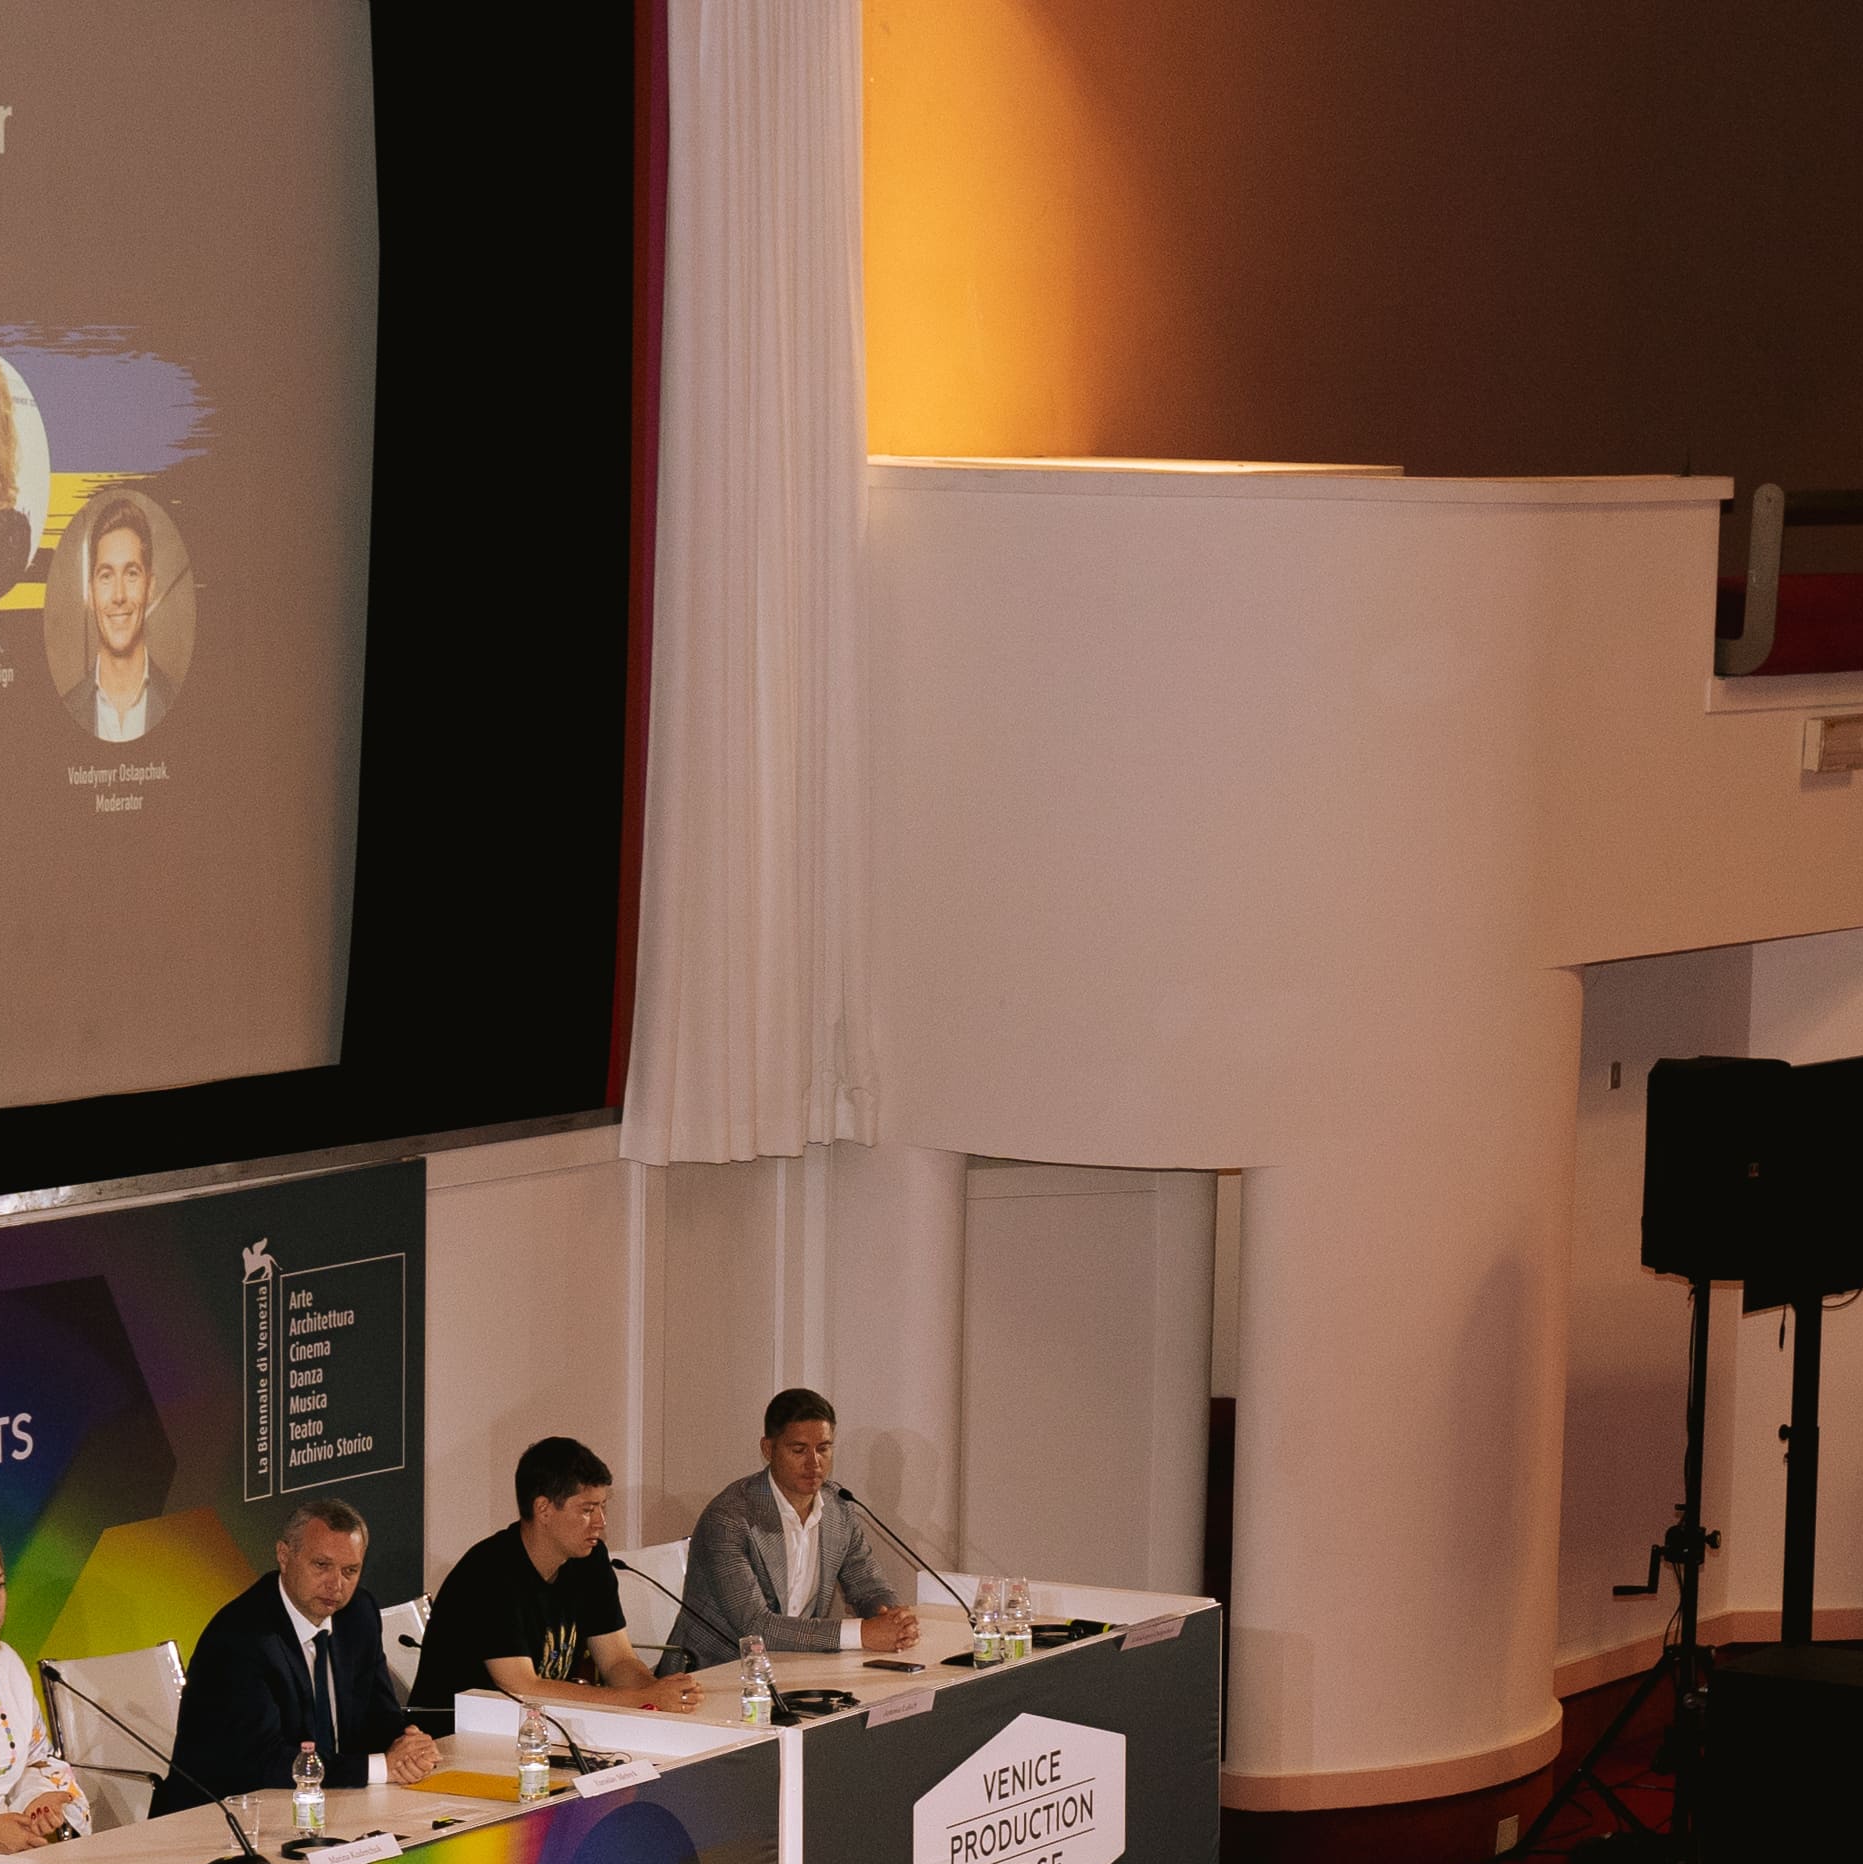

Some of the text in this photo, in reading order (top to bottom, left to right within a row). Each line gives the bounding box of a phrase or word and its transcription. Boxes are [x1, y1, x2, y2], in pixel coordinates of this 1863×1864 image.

[67, 765, 117, 789] Volodymyr
[96, 793, 144, 813] Moderator
[289, 1289, 313, 1311] Arte
[289, 1309, 355, 1337] Architettura
[289, 1340, 331, 1363] Cinema
[256, 1285, 268, 1474] La Biennale di Venezia
[289, 1367, 323, 1389] Danza
[289, 1391, 327, 1416] Musica
[289, 1418, 323, 1441] Teatro
[289, 1432, 373, 1468] Archivio Storico
[983, 1750, 1061, 1803] VENICE
